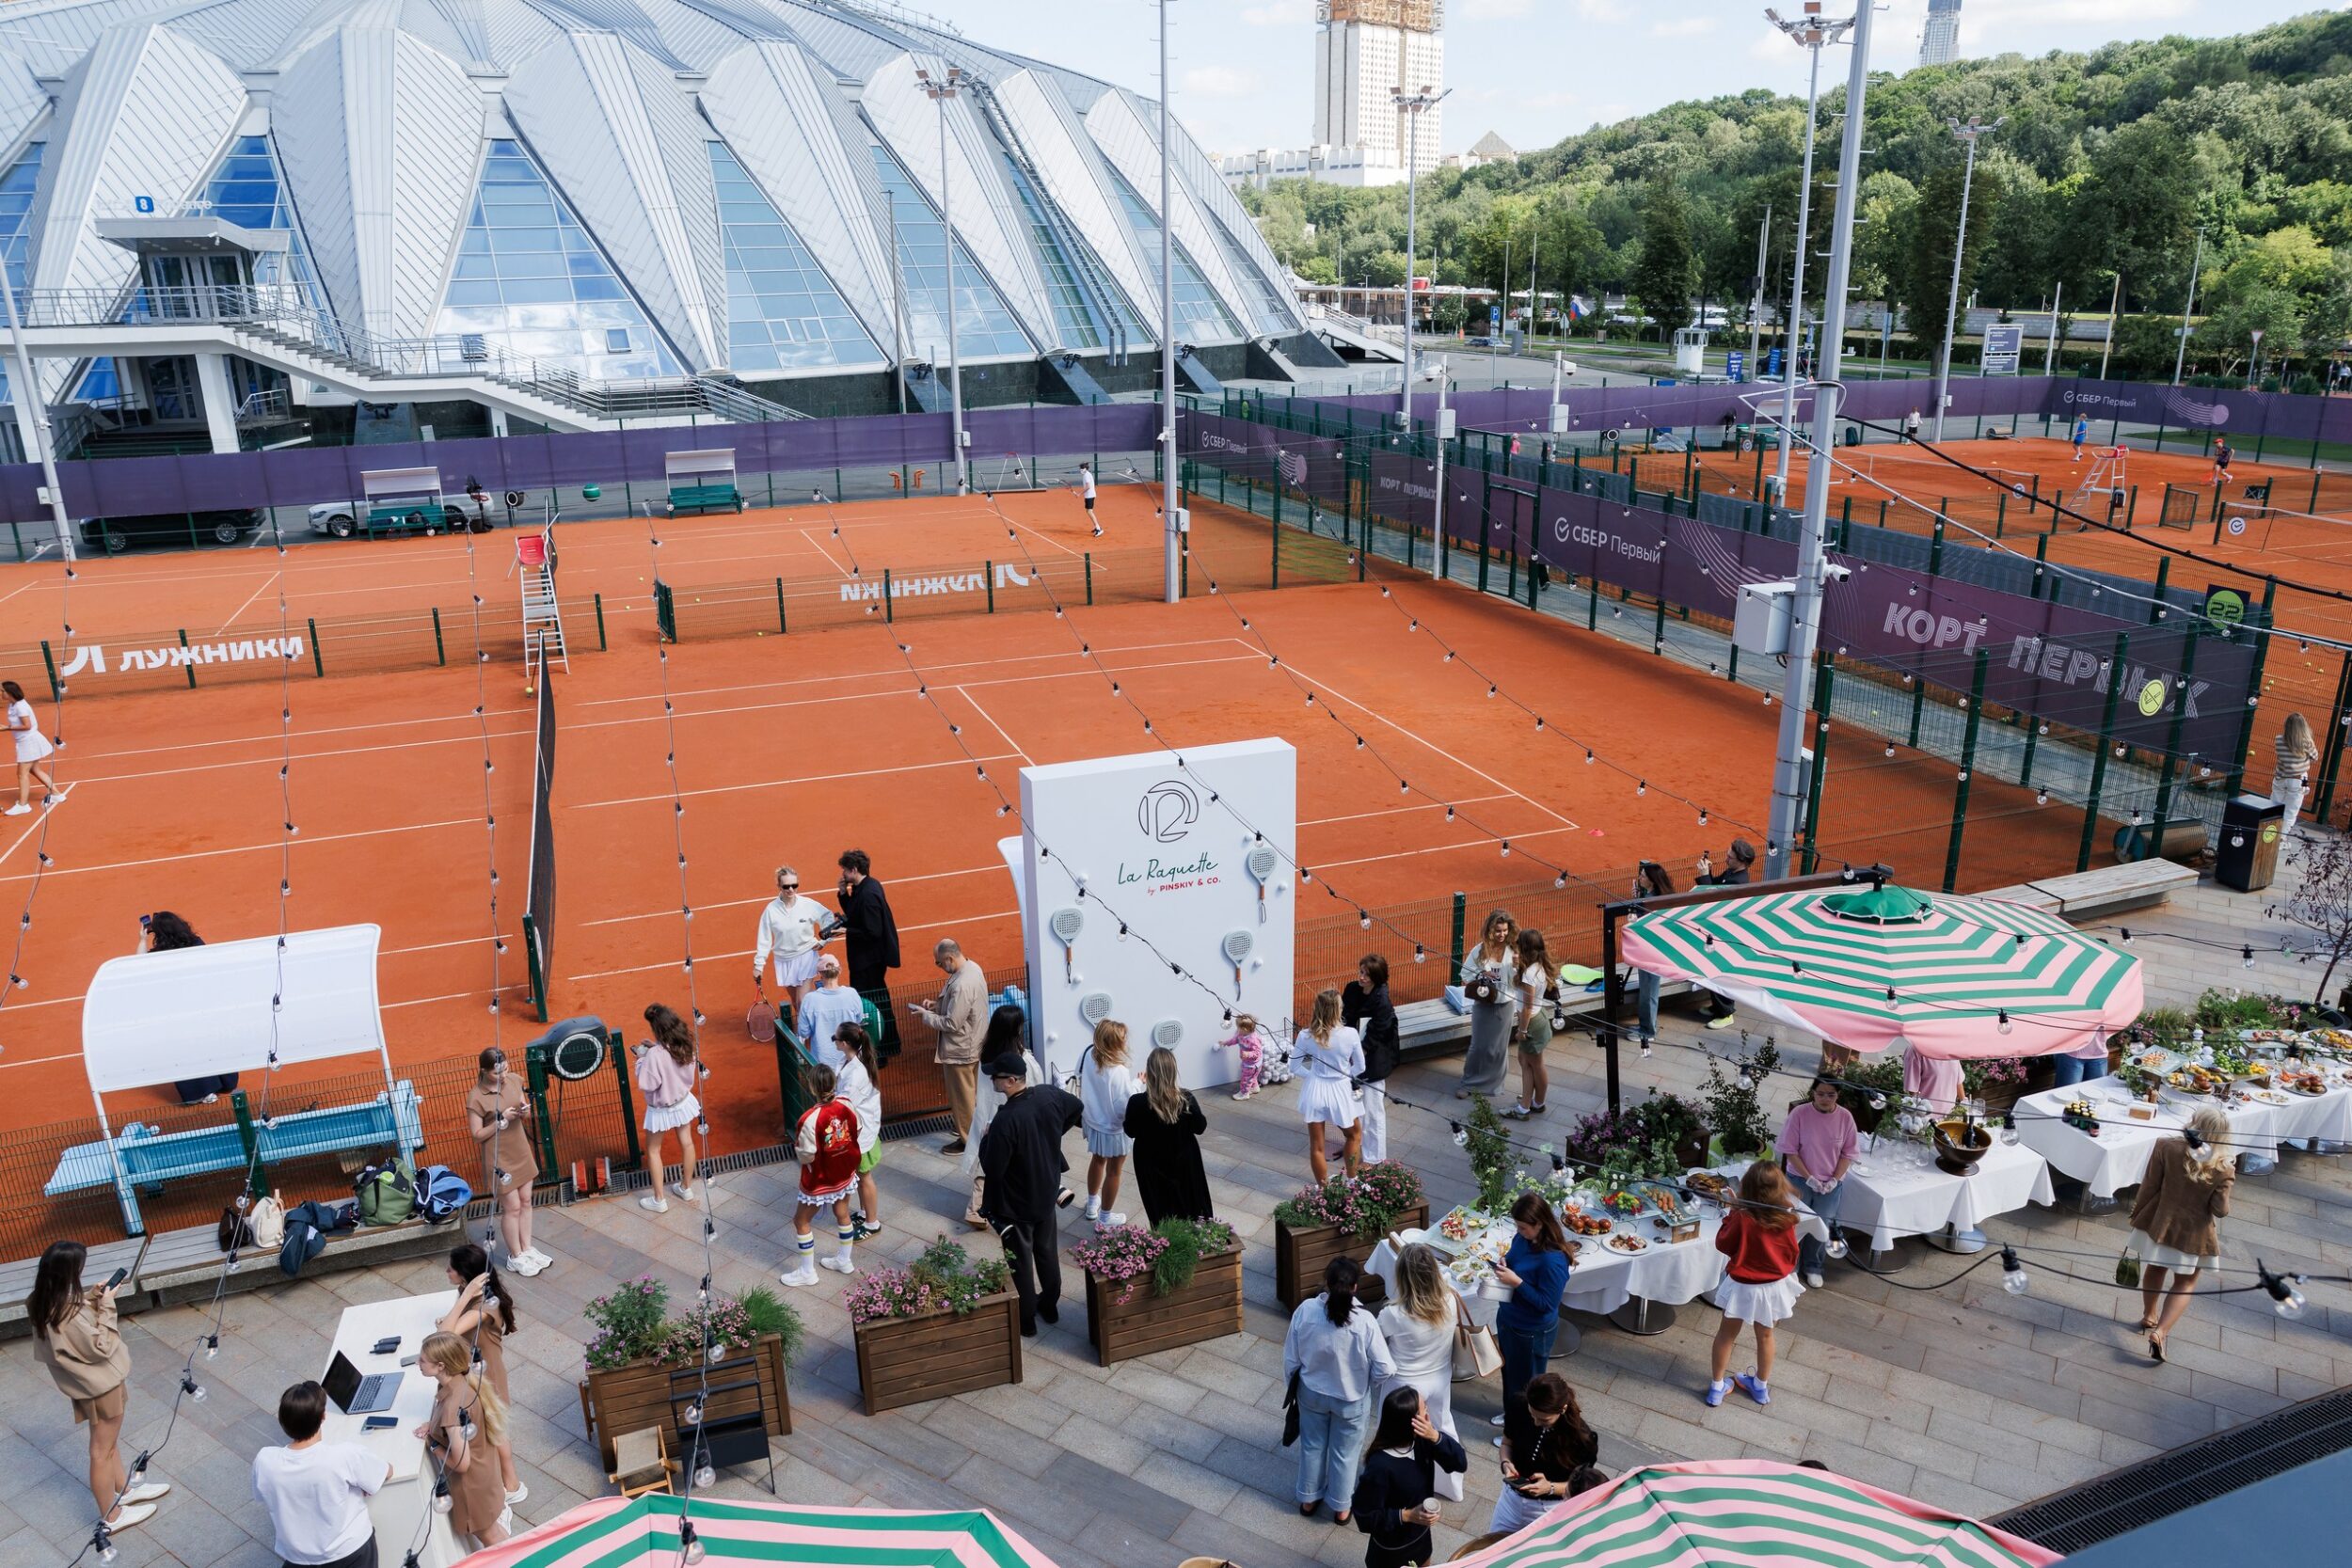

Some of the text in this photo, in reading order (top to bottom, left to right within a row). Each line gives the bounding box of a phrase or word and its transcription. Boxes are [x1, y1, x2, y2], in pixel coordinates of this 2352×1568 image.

[139, 198, 149, 211] 8
[2075, 393, 2137, 407] СБЕР Первый
[1209, 435, 1226, 449] СБЕР
[1379, 476, 1401, 492] КОРТ
[1572, 525, 1661, 564] СБЕР Первый
[2210, 601, 2240, 621] 22
[1883, 601, 1988, 657] КОРТ
[119, 635, 304, 673] ЛУЖНИКИ
[1118, 851, 1218, 885] La Raquette
[1159, 880, 1194, 892] PINSKIY
[1197, 878, 1203, 886] &
